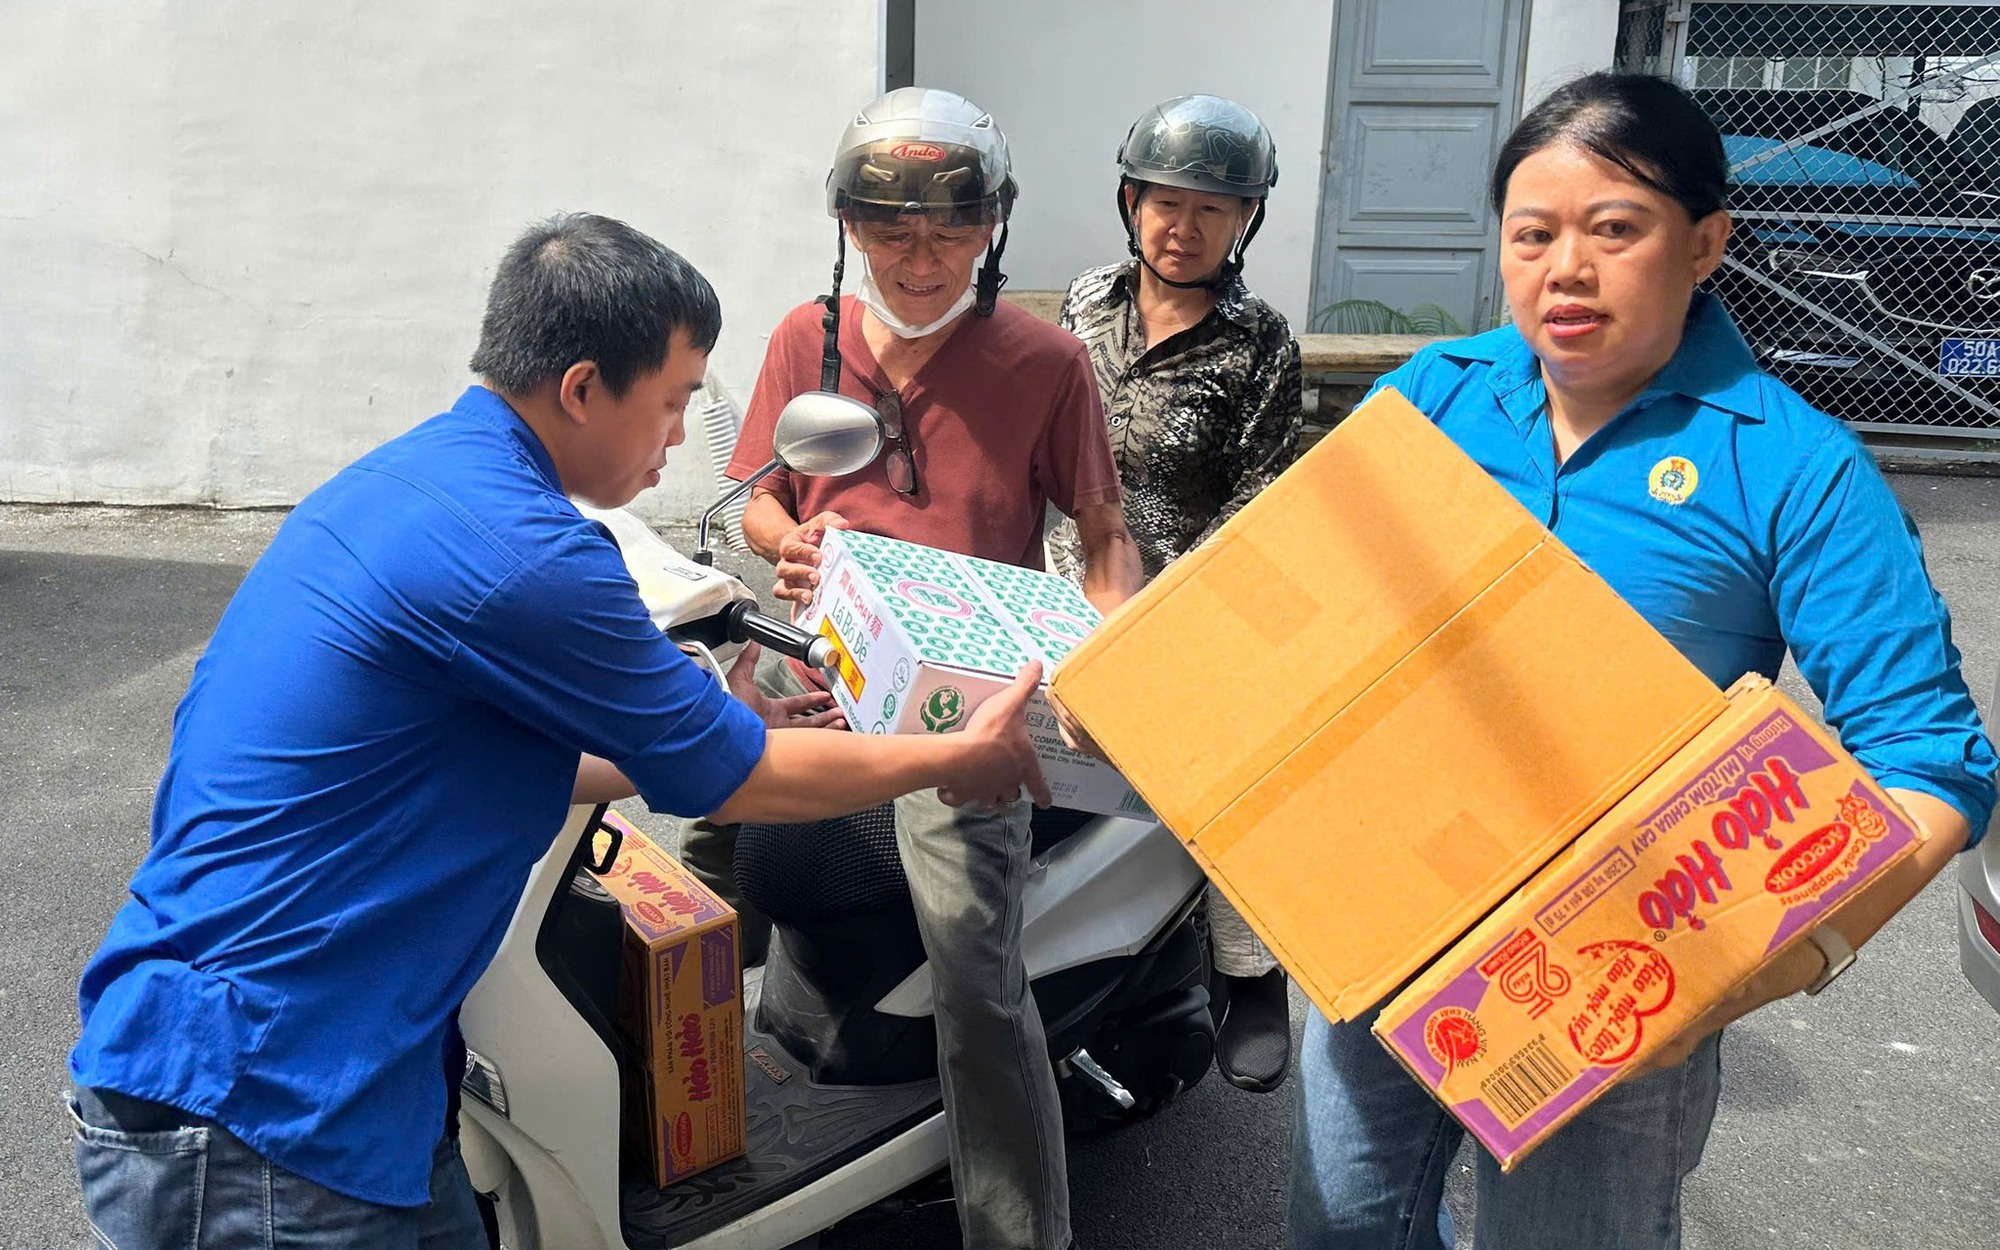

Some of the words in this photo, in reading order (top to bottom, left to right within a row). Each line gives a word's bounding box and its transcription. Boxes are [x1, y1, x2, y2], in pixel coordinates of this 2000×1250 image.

[897, 146, 945, 157] Andes
[1963, 340, 1996, 357] 50A
[1948, 358, 2000, 375] 022.6
[854, 594, 873, 625] CHAY
[1034, 735, 1067, 747] COMPAN
[1655, 798, 1690, 833] CHUA
[1711, 759, 1810, 850] Hảo
[1632, 828, 1657, 855] CAY
[1842, 837, 1868, 868] Cook
[1638, 840, 1733, 931] Hảo
[1780, 868, 1843, 906] happiness
[1499, 940, 1571, 1020] 25
[1455, 1055, 1478, 1067] NAM
